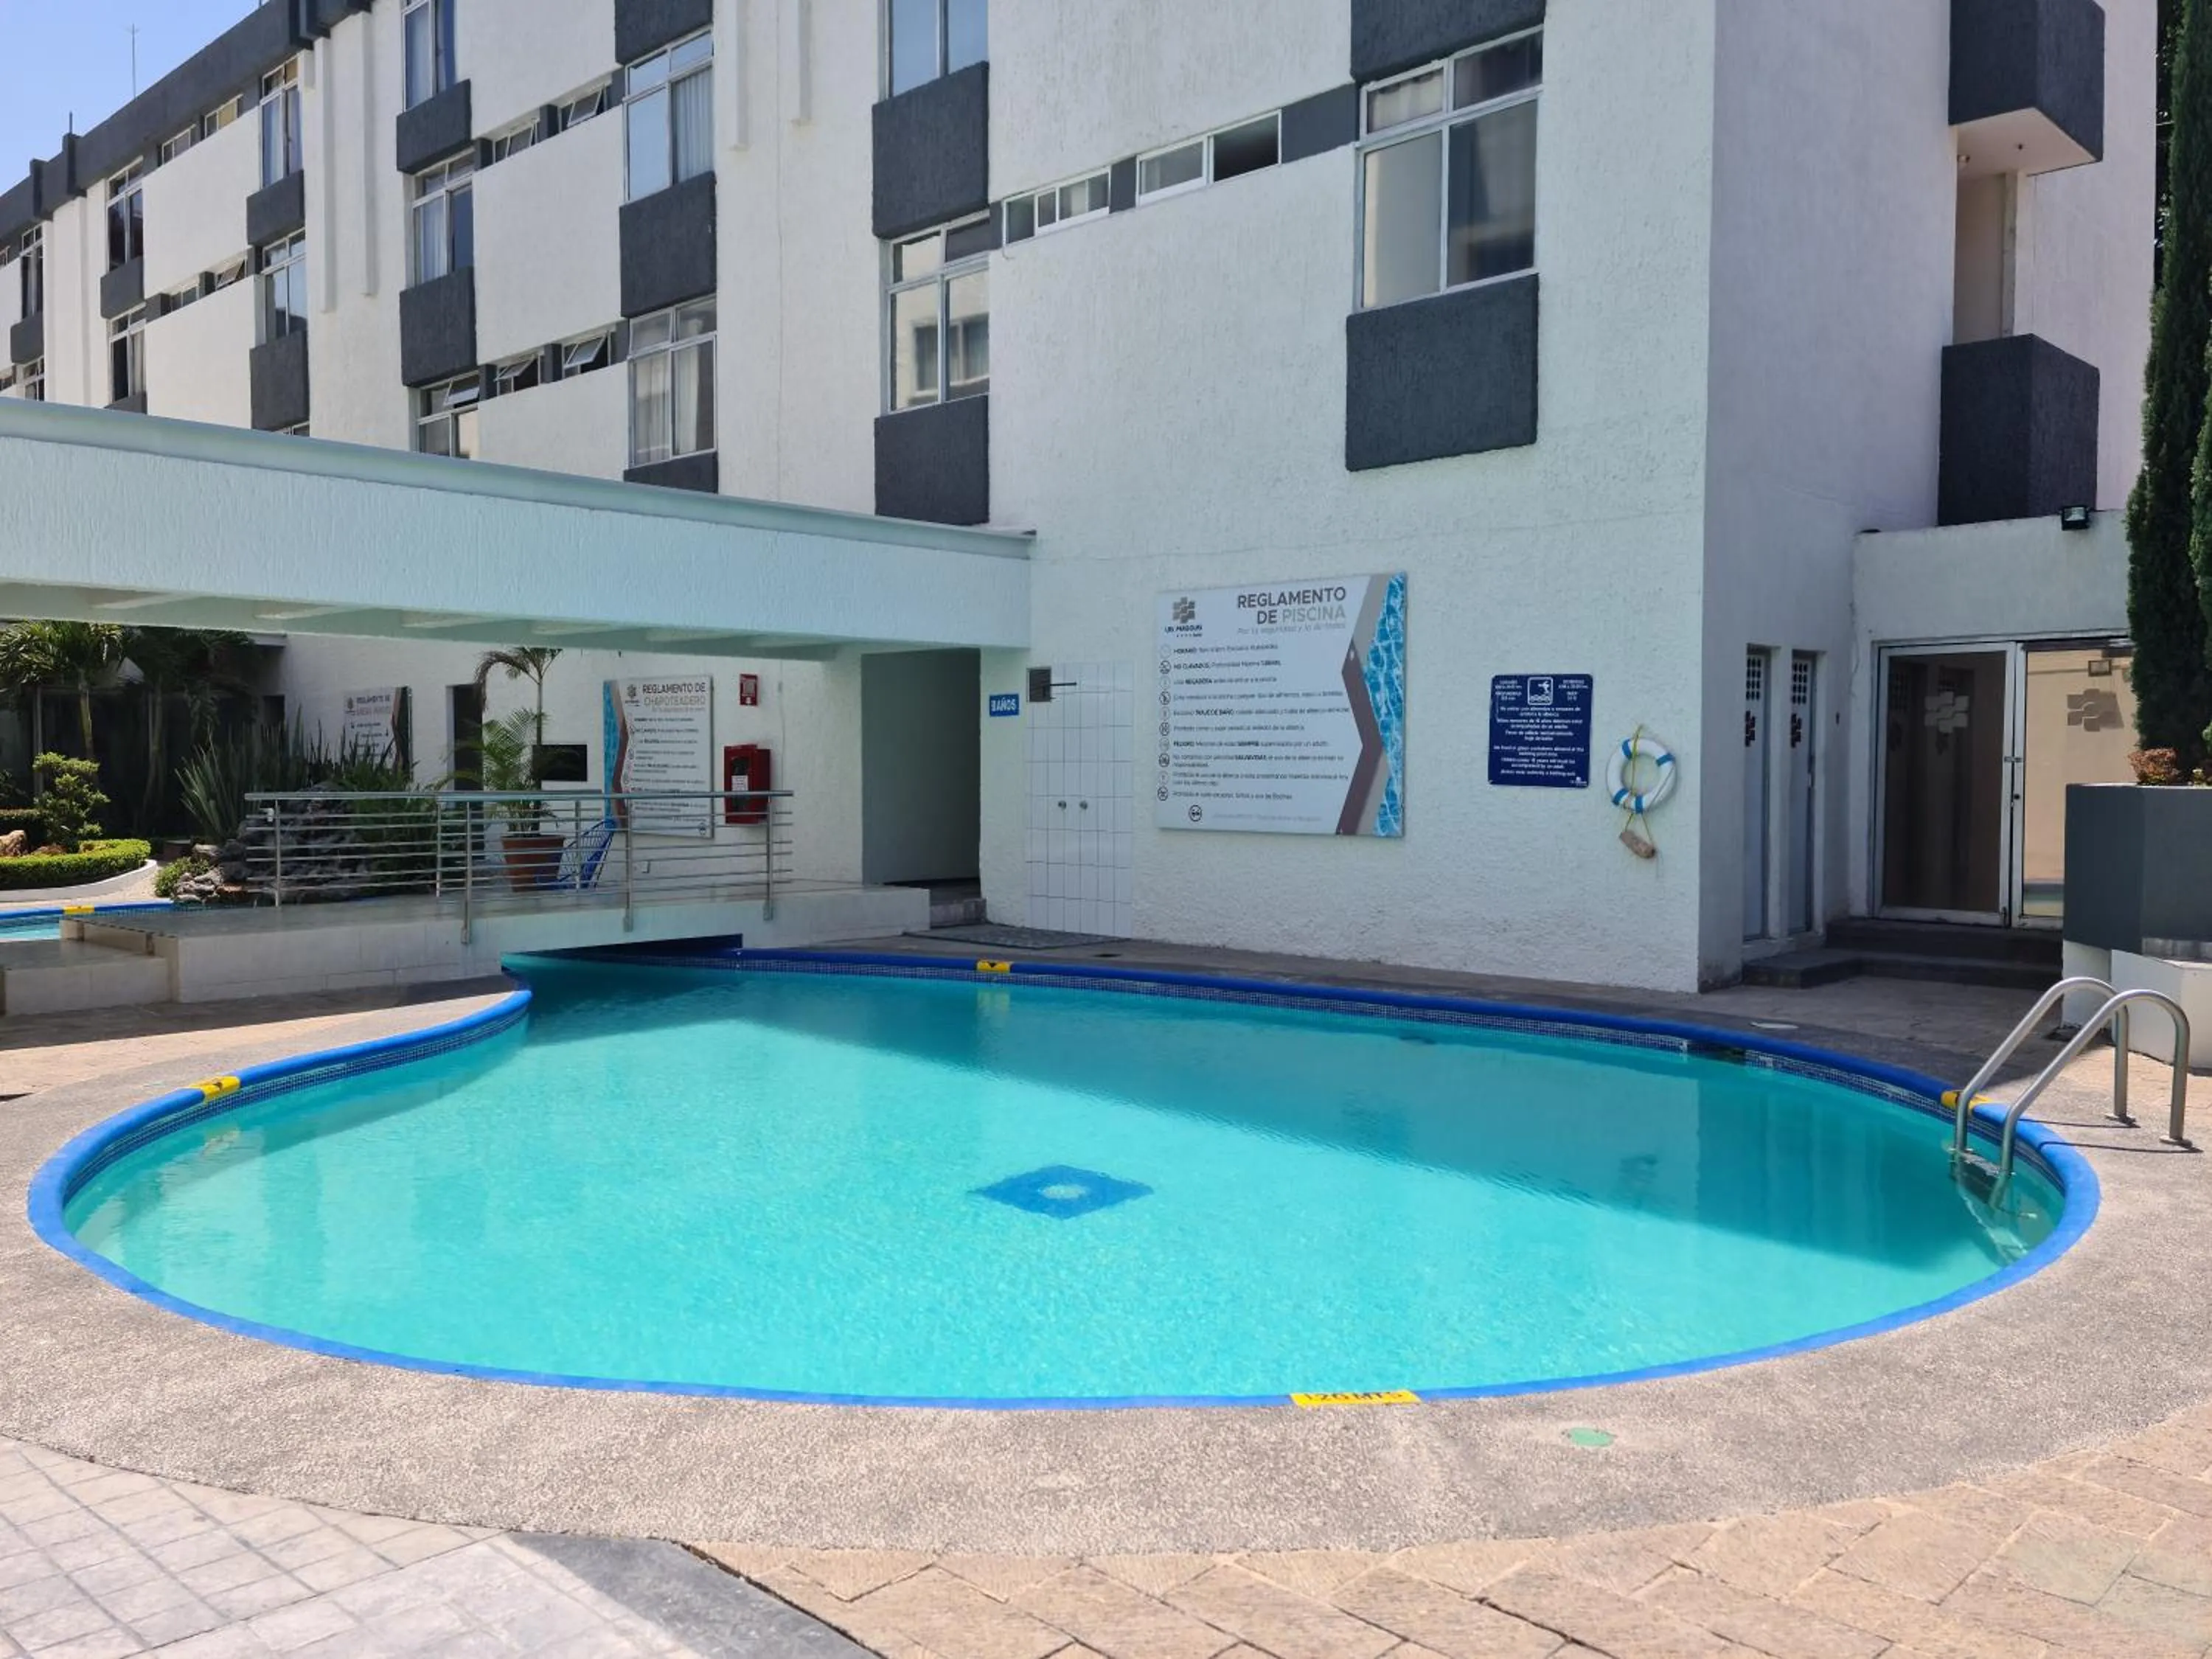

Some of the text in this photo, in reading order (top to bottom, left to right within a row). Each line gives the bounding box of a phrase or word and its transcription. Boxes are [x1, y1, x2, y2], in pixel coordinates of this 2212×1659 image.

[1237, 586, 1346, 608] REGLAMENTO
[1256, 605, 1346, 625] DE PISCINA
[643, 682, 706, 694] REGLAMENTO DE
[991, 697, 1016, 712] BAÑOS
